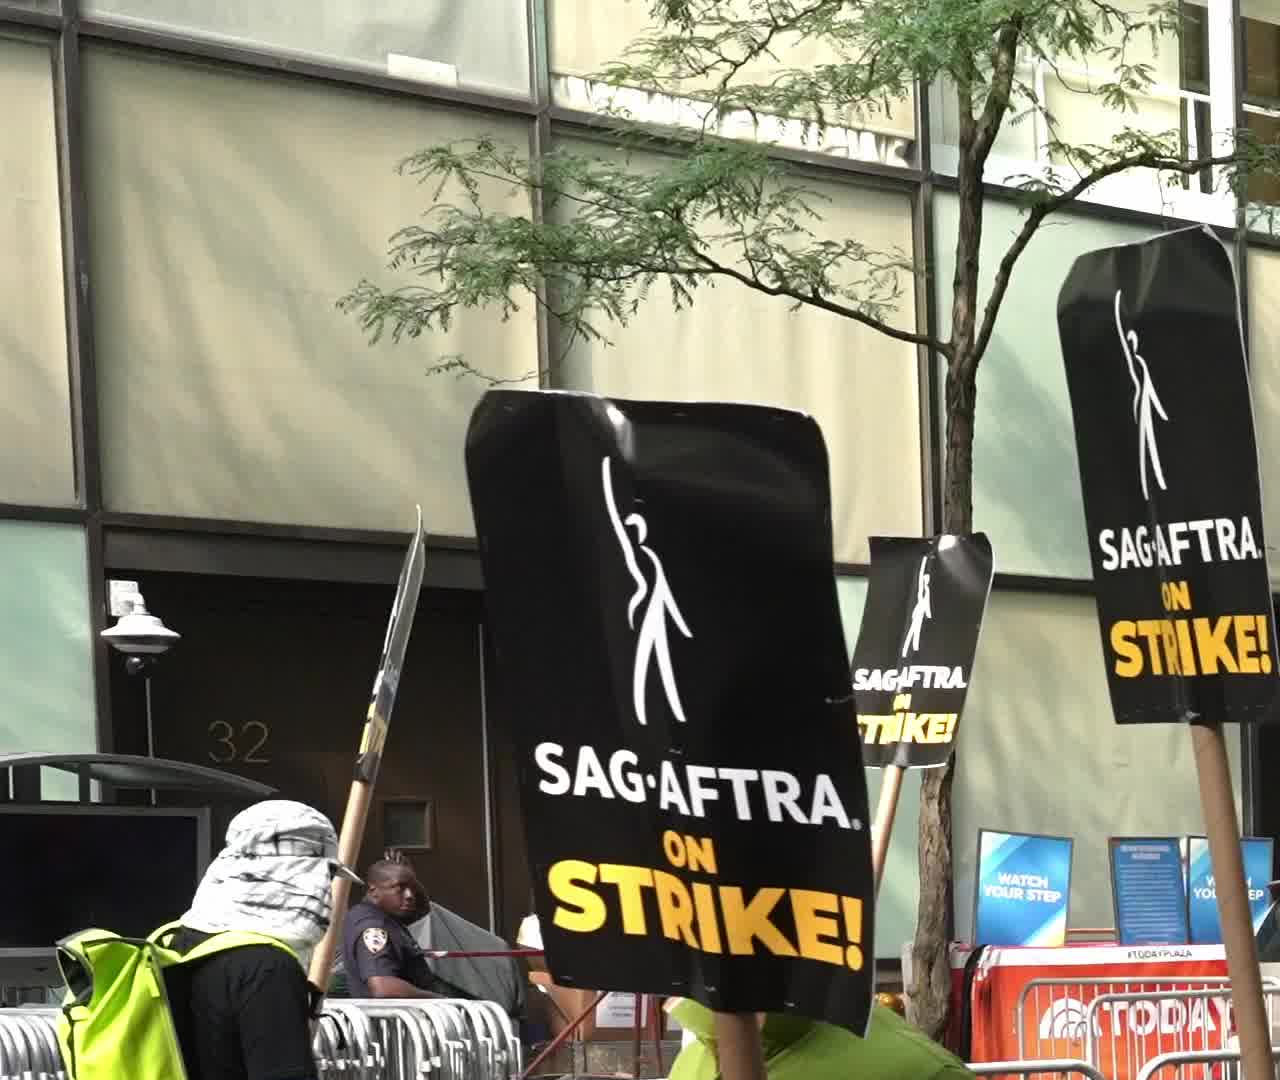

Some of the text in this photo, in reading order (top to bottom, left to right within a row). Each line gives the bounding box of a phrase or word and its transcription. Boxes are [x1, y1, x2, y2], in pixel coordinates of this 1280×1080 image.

[1161, 581, 1192, 612] ON
[1110, 615, 1273, 678] STRIKE!
[208, 720, 271, 763] 32
[663, 830, 718, 875] ON
[984, 884, 1062, 903] YOUR STEP
[998, 873, 1048, 889] WATCH
[547, 859, 864, 971] STRIKE!
